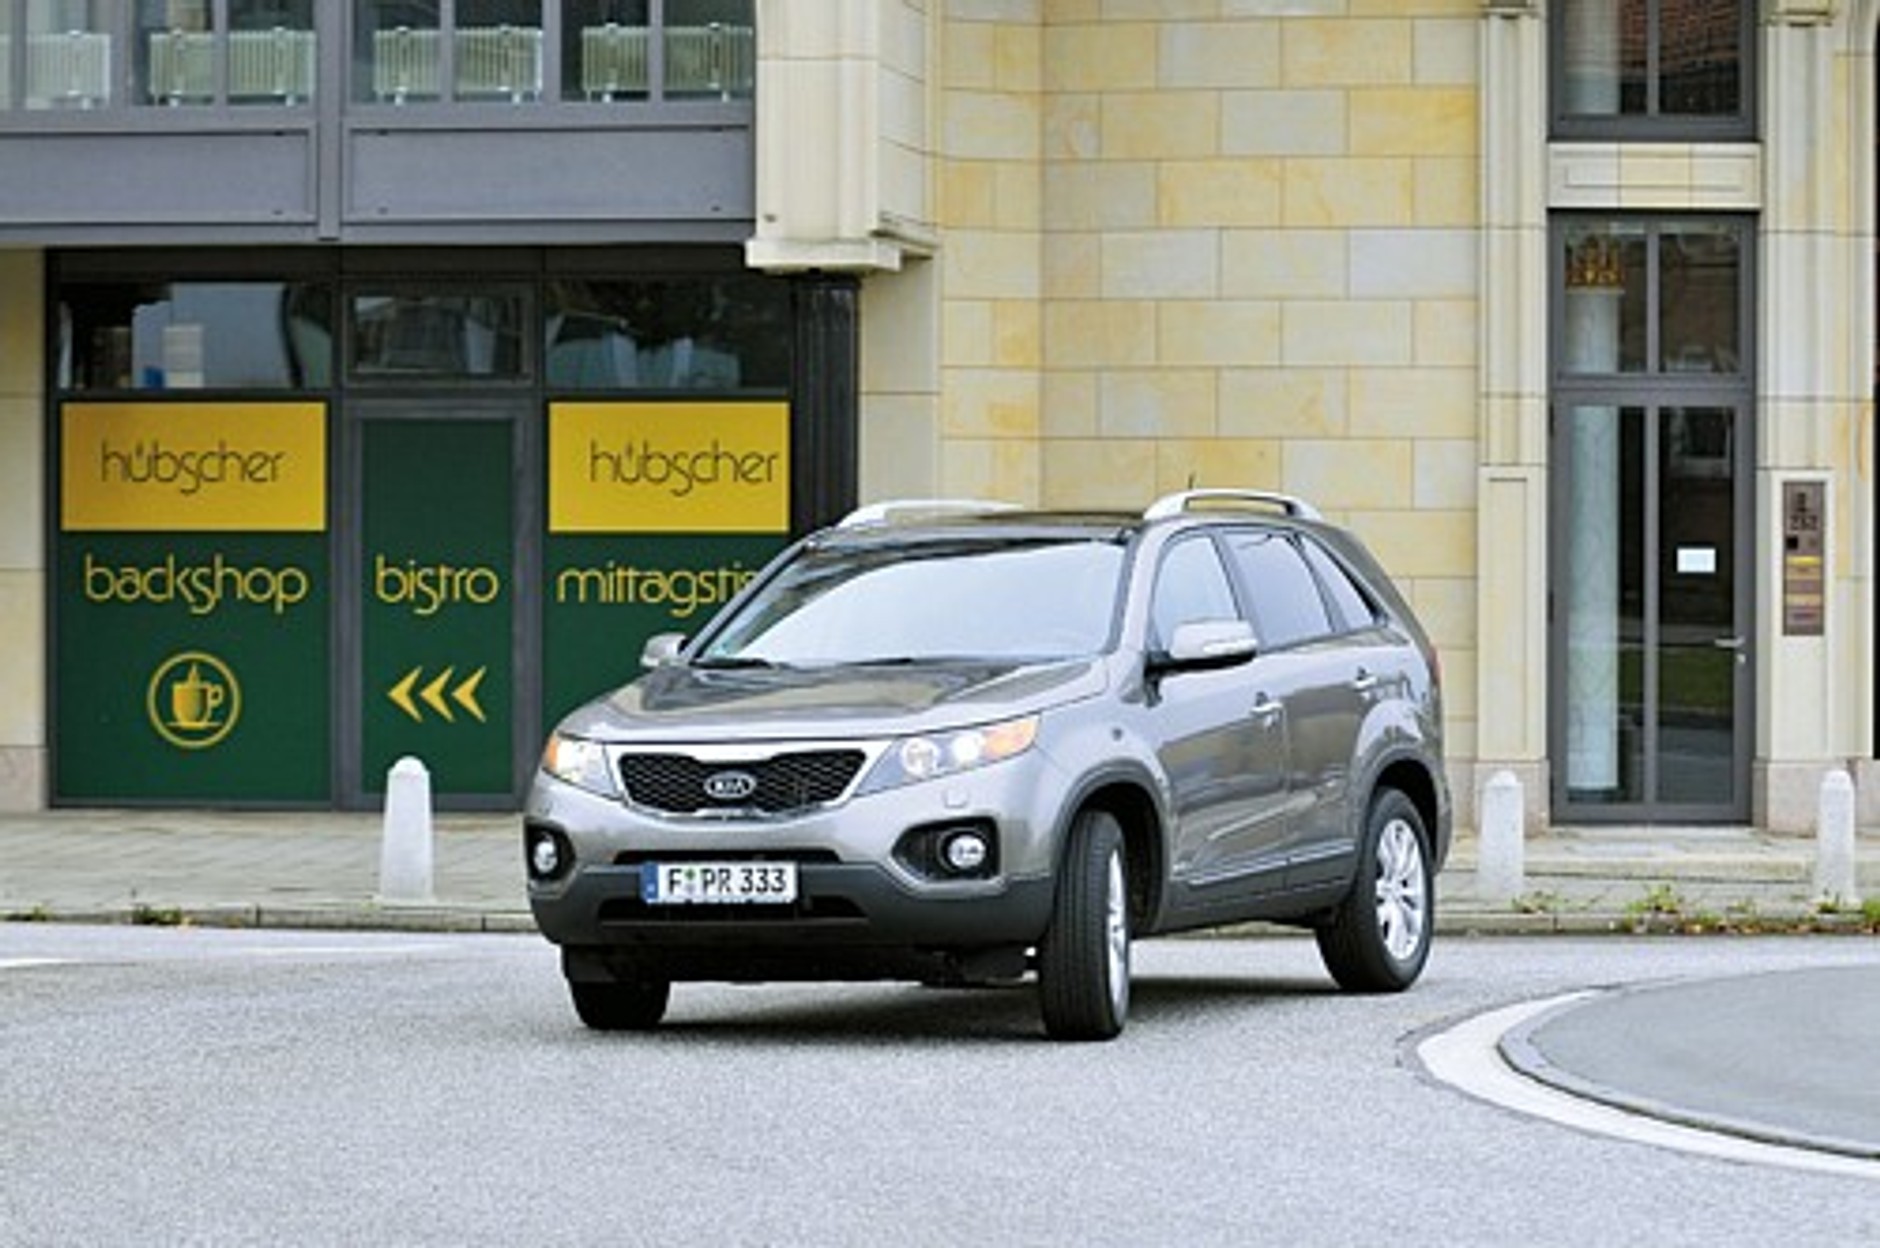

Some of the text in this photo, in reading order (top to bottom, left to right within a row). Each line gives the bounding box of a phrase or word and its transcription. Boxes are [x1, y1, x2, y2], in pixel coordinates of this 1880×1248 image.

[101, 440, 284, 495] hübscher
[590, 440, 779, 496] hübscher
[85, 553, 308, 614] backshop
[375, 554, 499, 615] bistro
[668, 868, 785, 894] F PR 333
